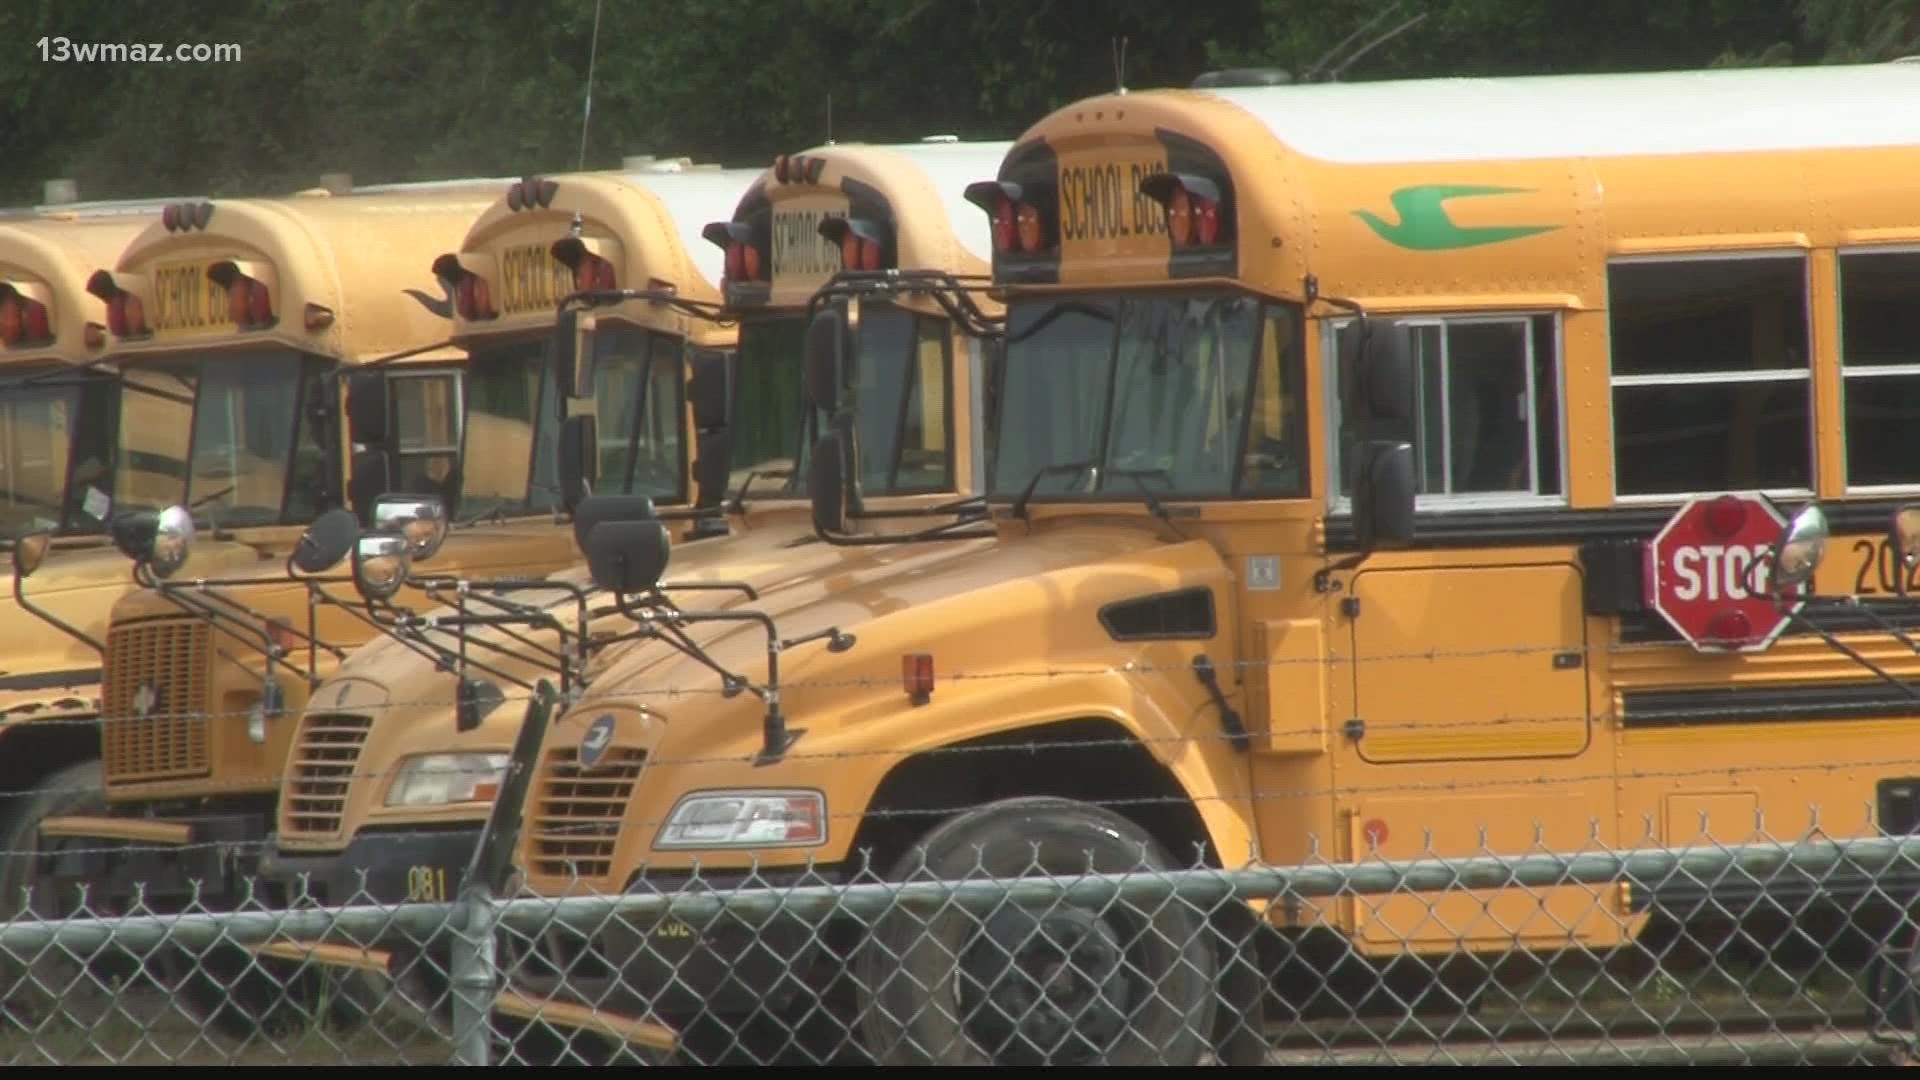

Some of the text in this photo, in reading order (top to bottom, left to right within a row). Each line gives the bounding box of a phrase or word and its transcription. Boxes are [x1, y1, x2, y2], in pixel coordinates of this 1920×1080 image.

[1062, 162, 1128, 240] SCHOOL
[774, 210, 820, 275] SCHOOL
[156, 264, 204, 329] SCHOOL
[503, 246, 550, 313] SCHOOL
